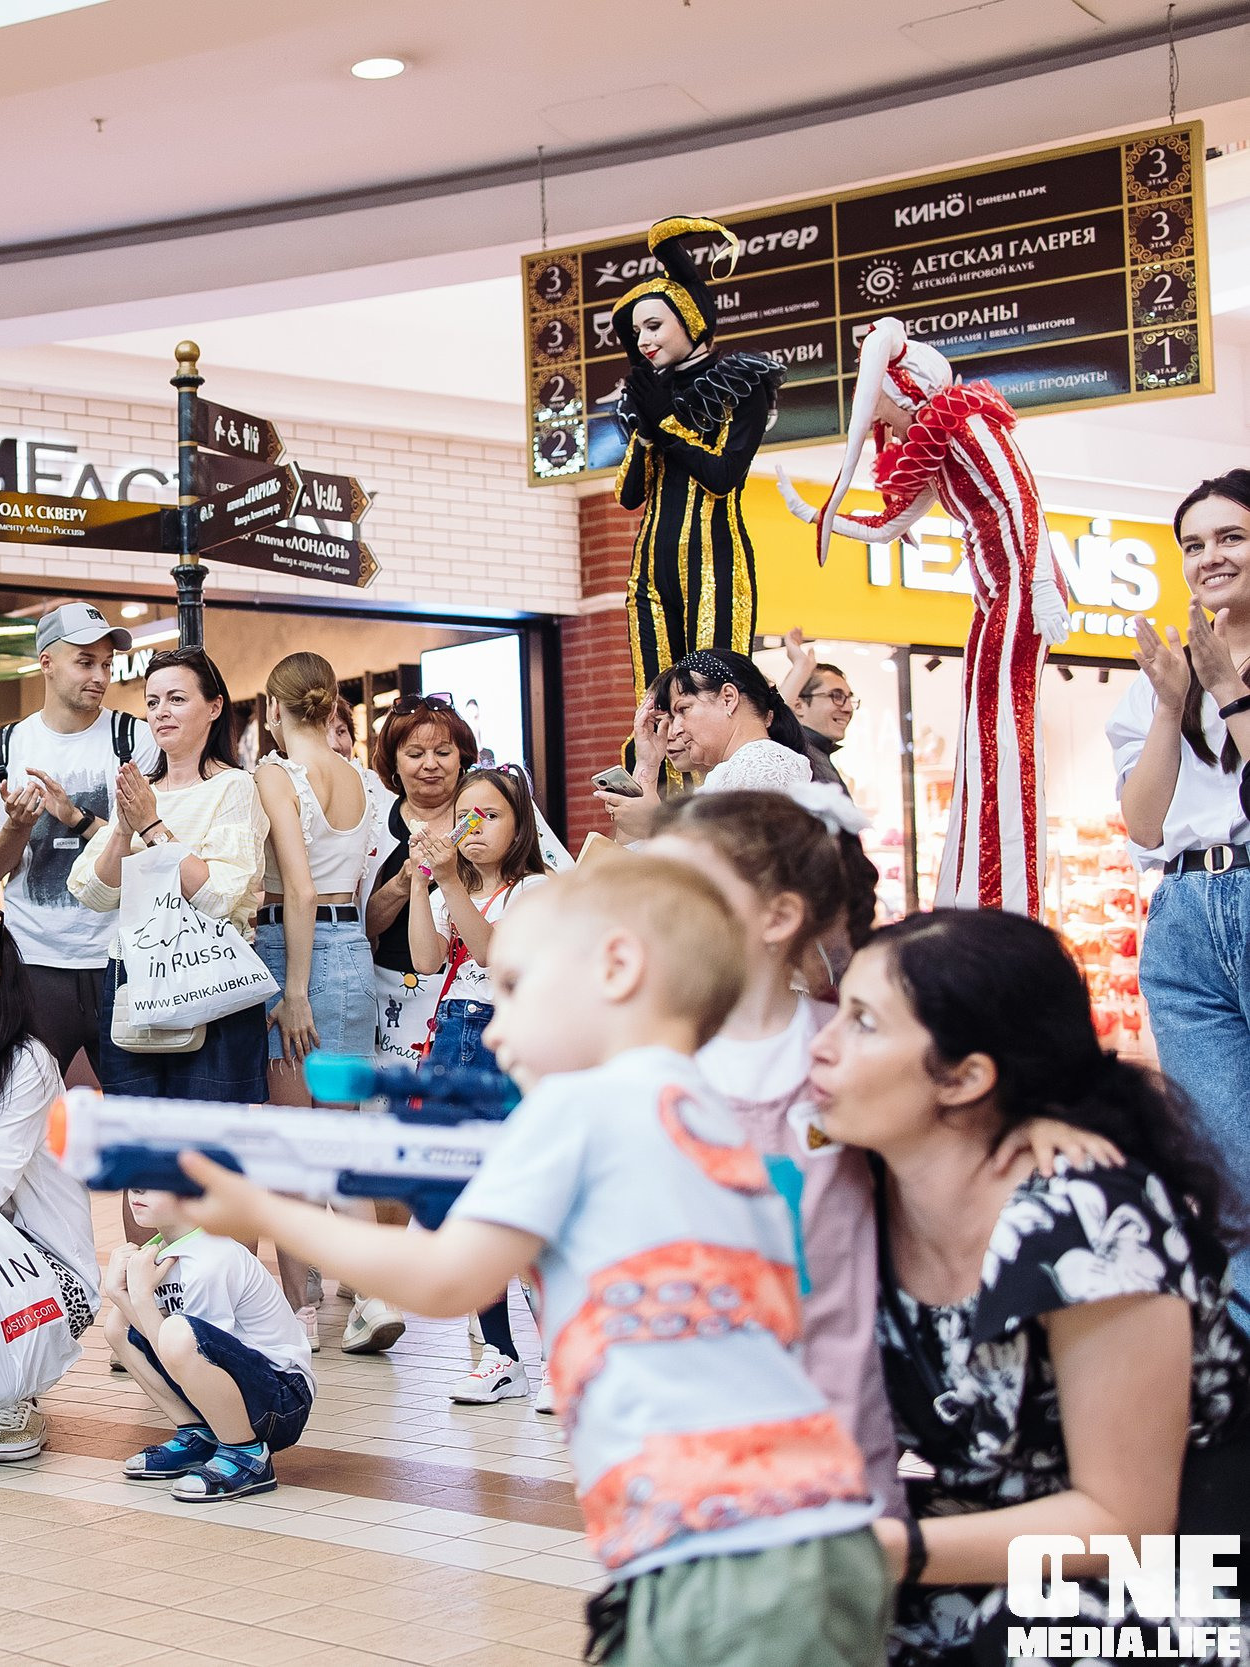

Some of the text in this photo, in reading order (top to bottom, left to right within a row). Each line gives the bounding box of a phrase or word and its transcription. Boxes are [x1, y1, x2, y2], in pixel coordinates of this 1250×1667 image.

[1149, 148, 1167, 178] 3
[976, 194, 1017, 206] СИНЕМА
[1018, 185, 1047, 198] ПАРК
[1151, 211, 1170, 241] 3
[911, 226, 1096, 276] ДЕТСКАЯ ГАЛЕРЕЯ
[546, 266, 561, 293] 3
[1008, 260, 1036, 273] КЛУБ
[1153, 273, 1173, 304] 2
[904, 302, 1018, 336] ЕСТОРАНЫ
[548, 321, 563, 348] 3
[1156, 336, 1171, 366] 1
[550, 376, 566, 402] 2
[996, 370, 1108, 396] ЕЖИЕ ПРОДУКТЫ
[551, 430, 567, 457] 2
[313, 479, 343, 512] Ville
[24, 504, 34, 518] К
[36, 505, 88, 522] СКВЕРУ
[285, 536, 350, 560] «ЛОНДОН»
[149, 956, 166, 978] in
[6, 1303, 58, 1335] ostin.com
